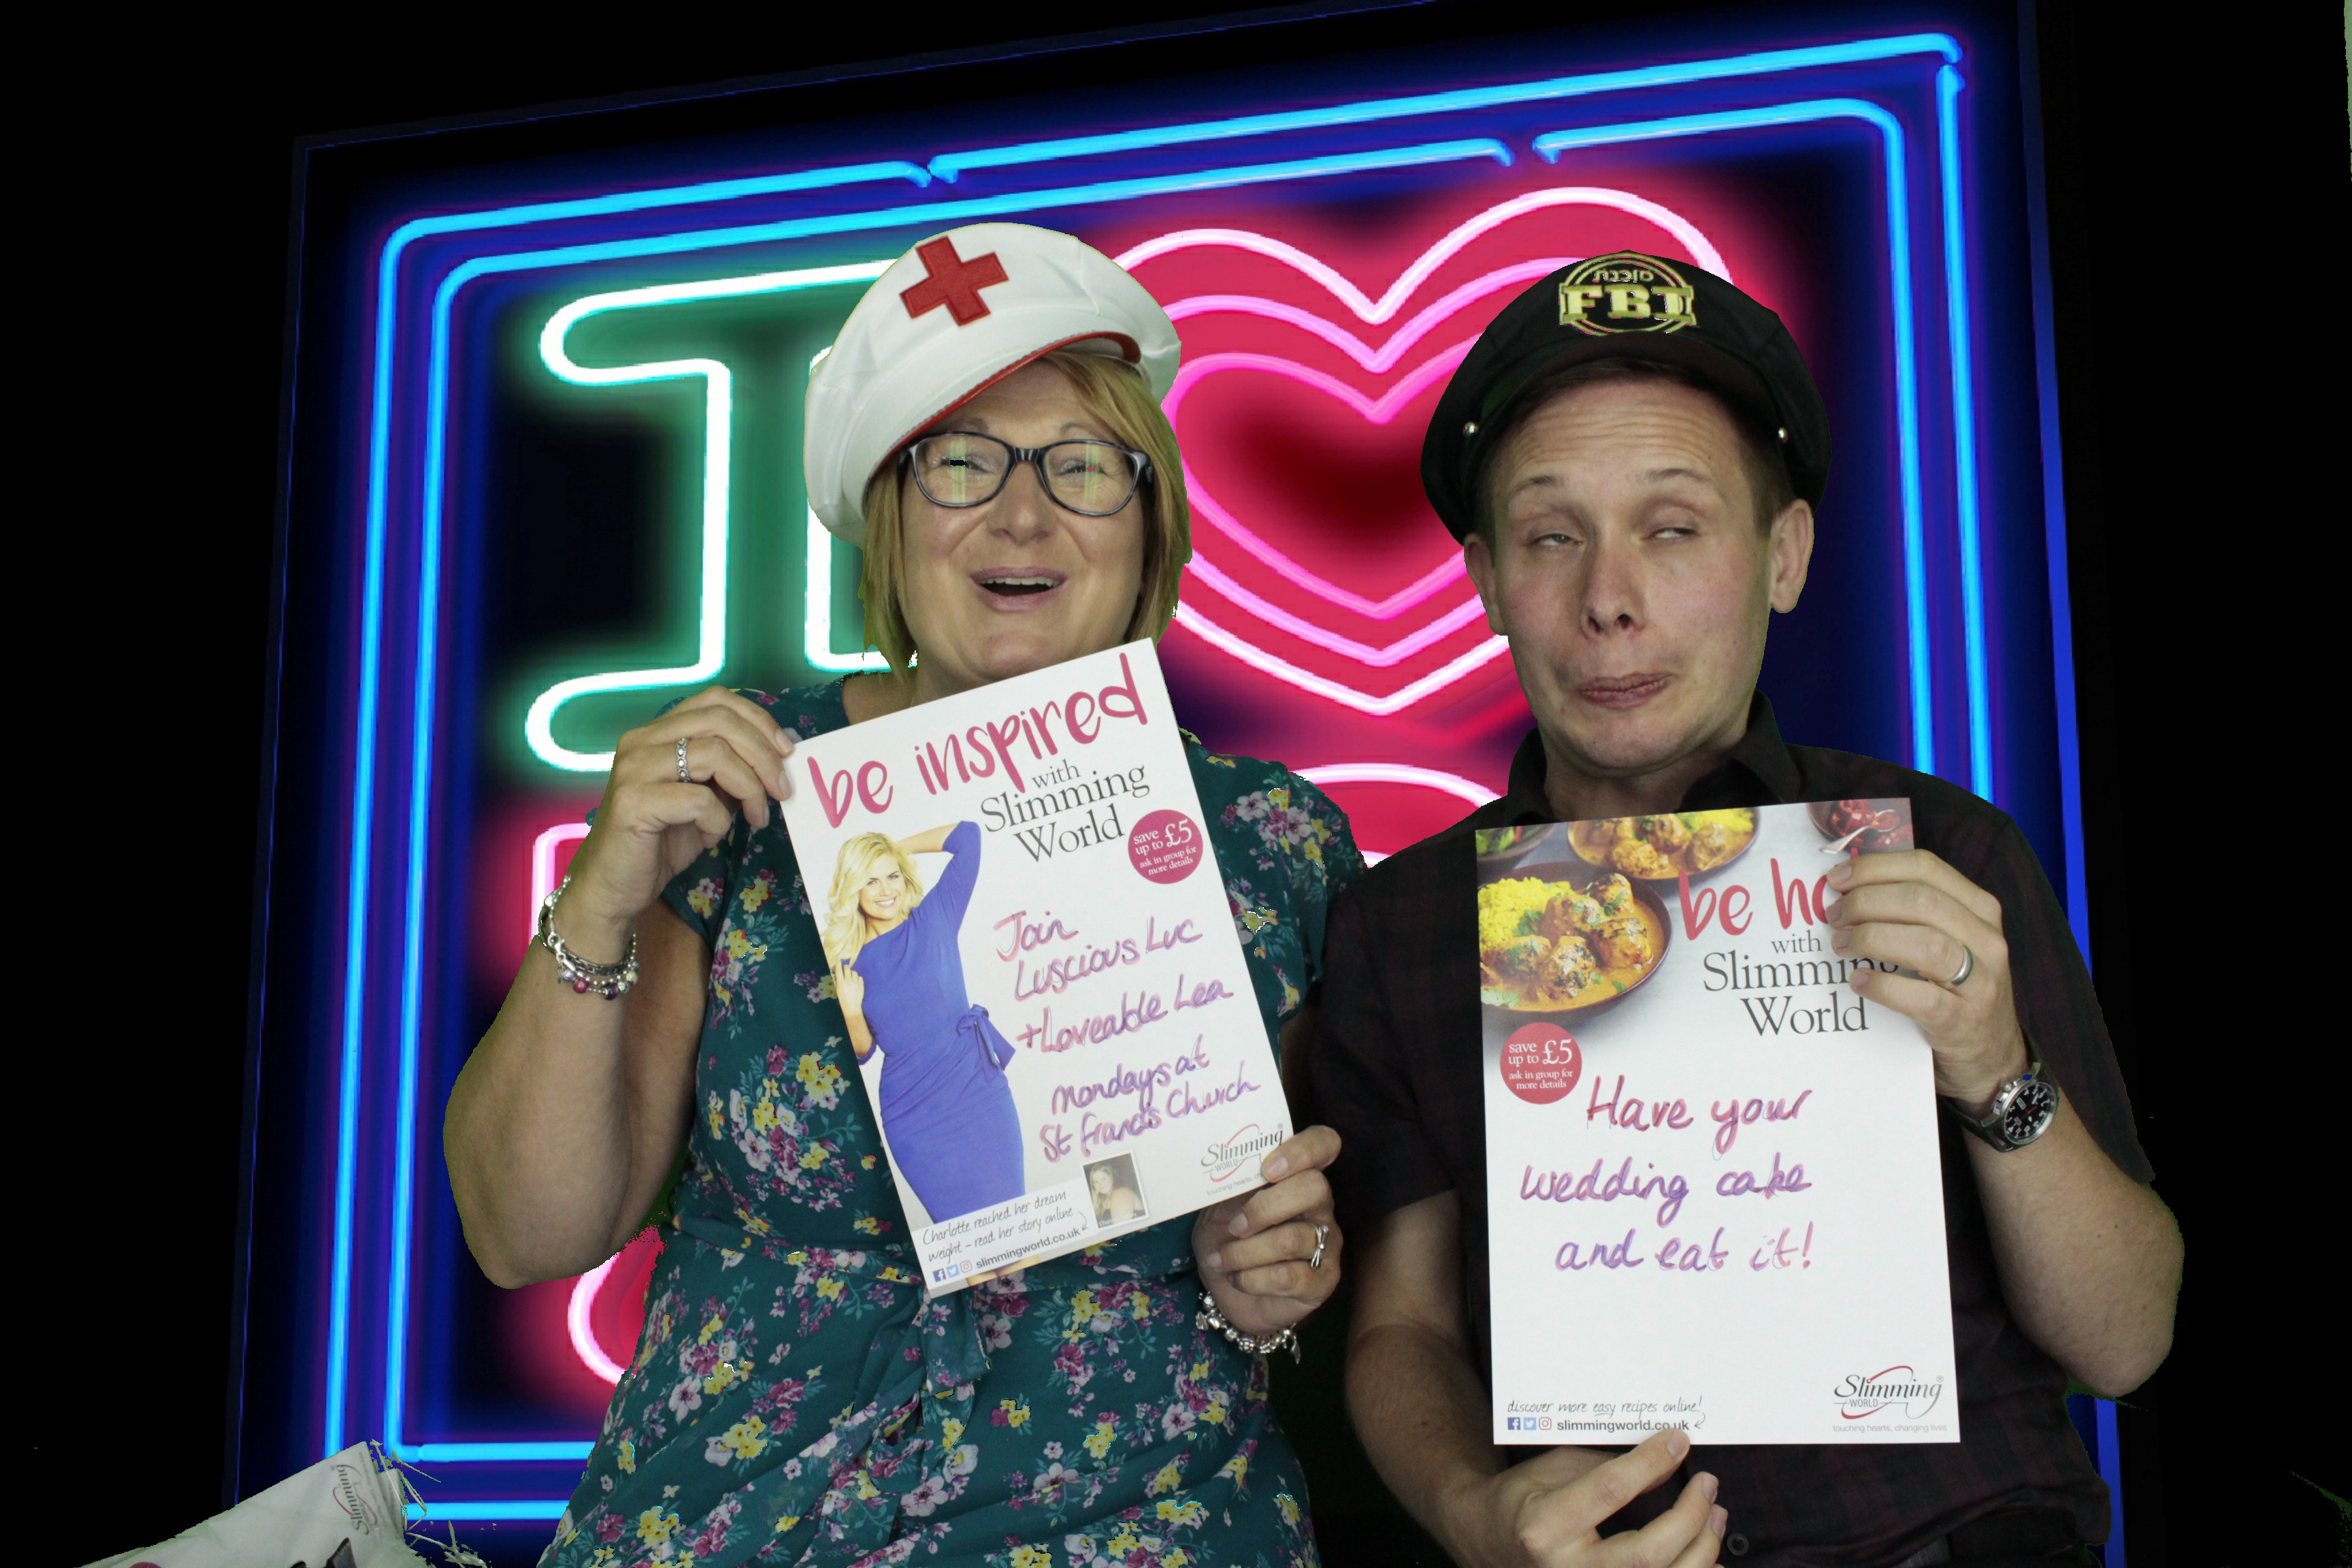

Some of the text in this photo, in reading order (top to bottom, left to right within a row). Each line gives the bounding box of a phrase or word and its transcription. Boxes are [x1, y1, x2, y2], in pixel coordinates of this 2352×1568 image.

[1558, 283, 1697, 326] FBI
[807, 653, 1148, 828] be inspired
[1031, 760, 1082, 789] with
[981, 766, 1150, 834] Slimming
[1013, 804, 1125, 863] World
[1134, 830, 1159, 845] save
[1135, 819, 1192, 856] up to £5
[1140, 858, 1152, 868] ask
[1163, 850, 1184, 863] group
[1186, 846, 1196, 854] for
[1148, 856, 1193, 875] more details
[1678, 869, 1753, 941] be
[994, 910, 1078, 962] Join
[1771, 930, 1823, 954] with
[1014, 938, 1140, 1001] Luscious
[1174, 974, 1234, 1011] Lea
[1740, 991, 1869, 1036] World
[1175, 1034, 1210, 1073] at
[1508, 1039, 1572, 1067] up to £5
[1509, 1043, 1537, 1054] save
[1509, 1068, 1573, 1081] ask in group for
[1539, 1079, 1567, 1088] details
[1039, 1124, 1072, 1163] St
[1166, 1060, 1260, 1120] Church
[1586, 1075, 1812, 1160] Have your
[1200, 1130, 1283, 1166] Slimming
[1215, 1159, 1238, 1172] WORLD
[1207, 1182, 1232, 1196] touching
[1716, 1152, 1812, 1198] cake
[923, 1191, 1066, 1245] Charlotte reached her dream
[928, 1241, 962, 1264] weight
[975, 1233, 996, 1249] read
[998, 1227, 1015, 1240] her
[1018, 1218, 1041, 1233] story
[1045, 1206, 1074, 1225] online
[976, 1228, 1081, 1269] slimmingworld.co.uk
[1555, 1228, 1644, 1271] and
[1657, 1226, 1729, 1271] eat
[1507, 1395, 1702, 1420] discover more easy recipes online!
[1834, 1375, 1942, 1419] Slimming
[1850, 1399, 1878, 1407] WORLD
